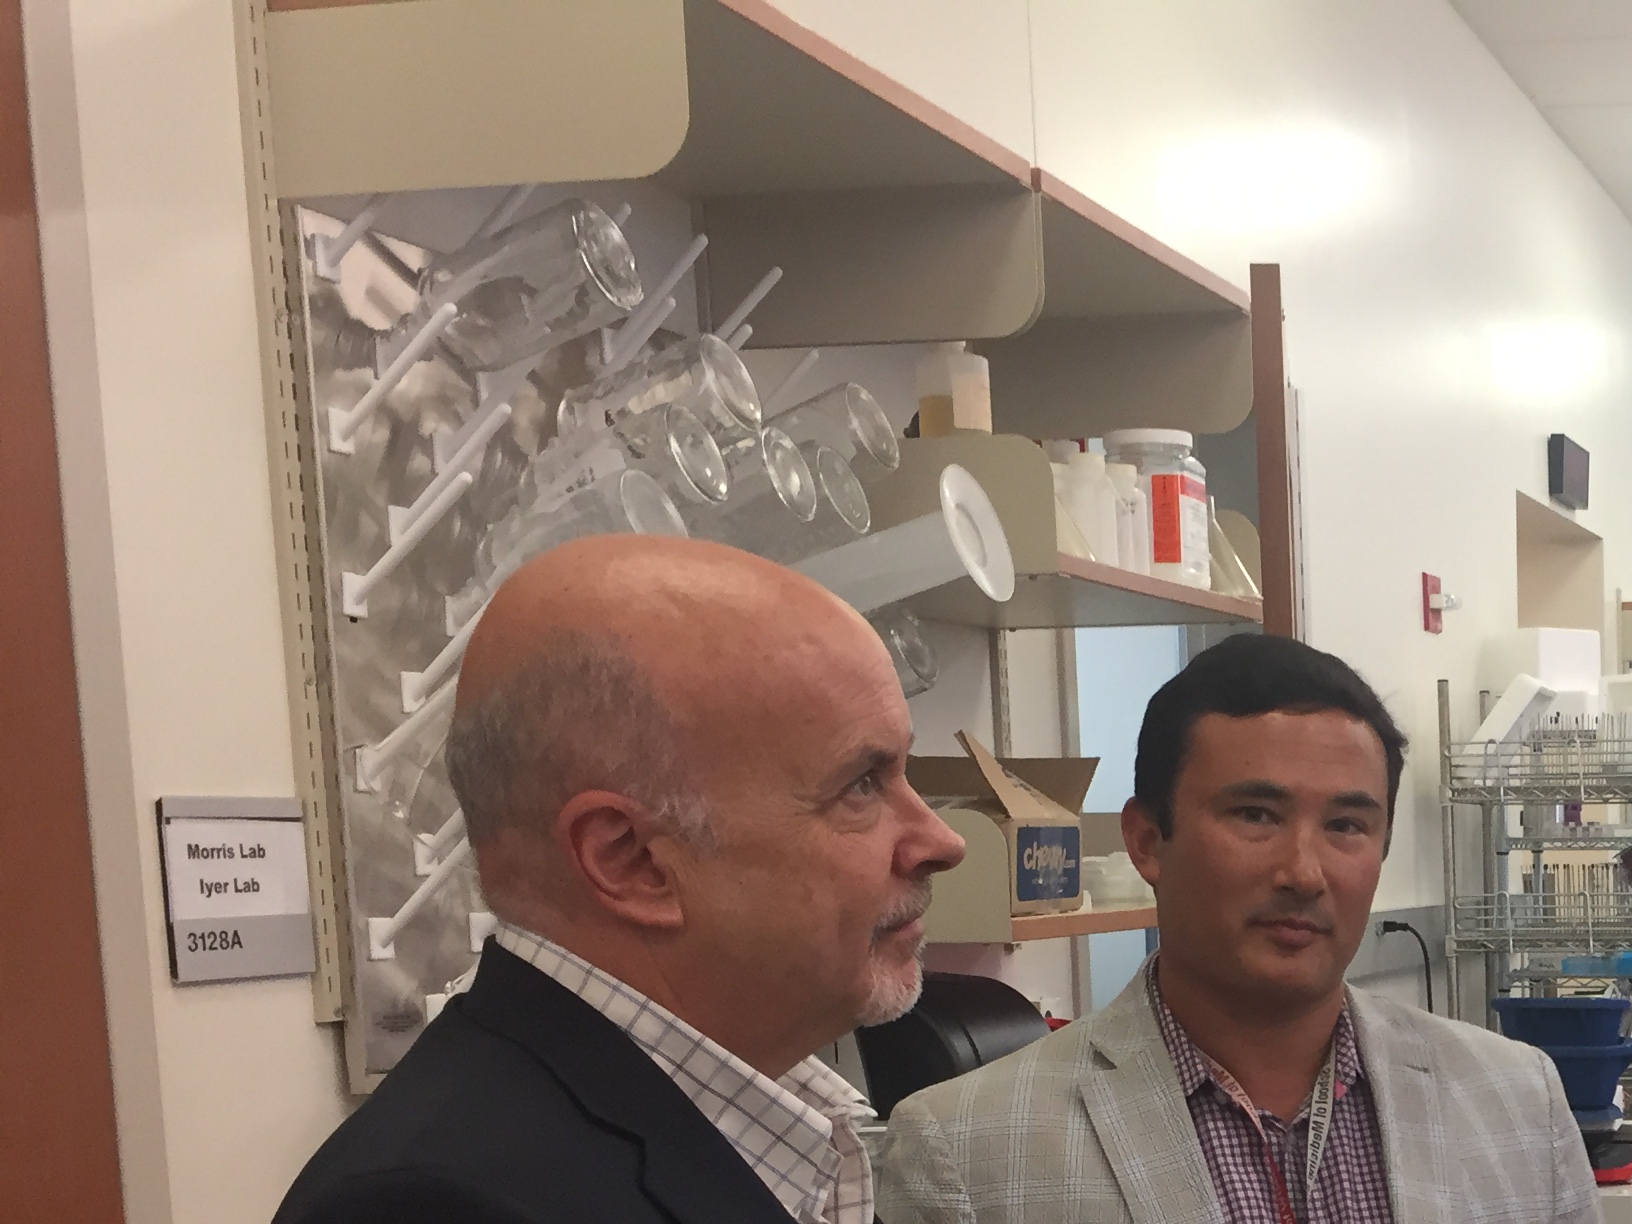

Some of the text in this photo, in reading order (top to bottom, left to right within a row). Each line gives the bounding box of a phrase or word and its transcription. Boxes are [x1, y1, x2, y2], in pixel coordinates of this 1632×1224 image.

[187, 843, 266, 860] Morris Lab
[199, 877, 260, 898] Iyer Lab
[187, 929, 243, 952] 3128A
